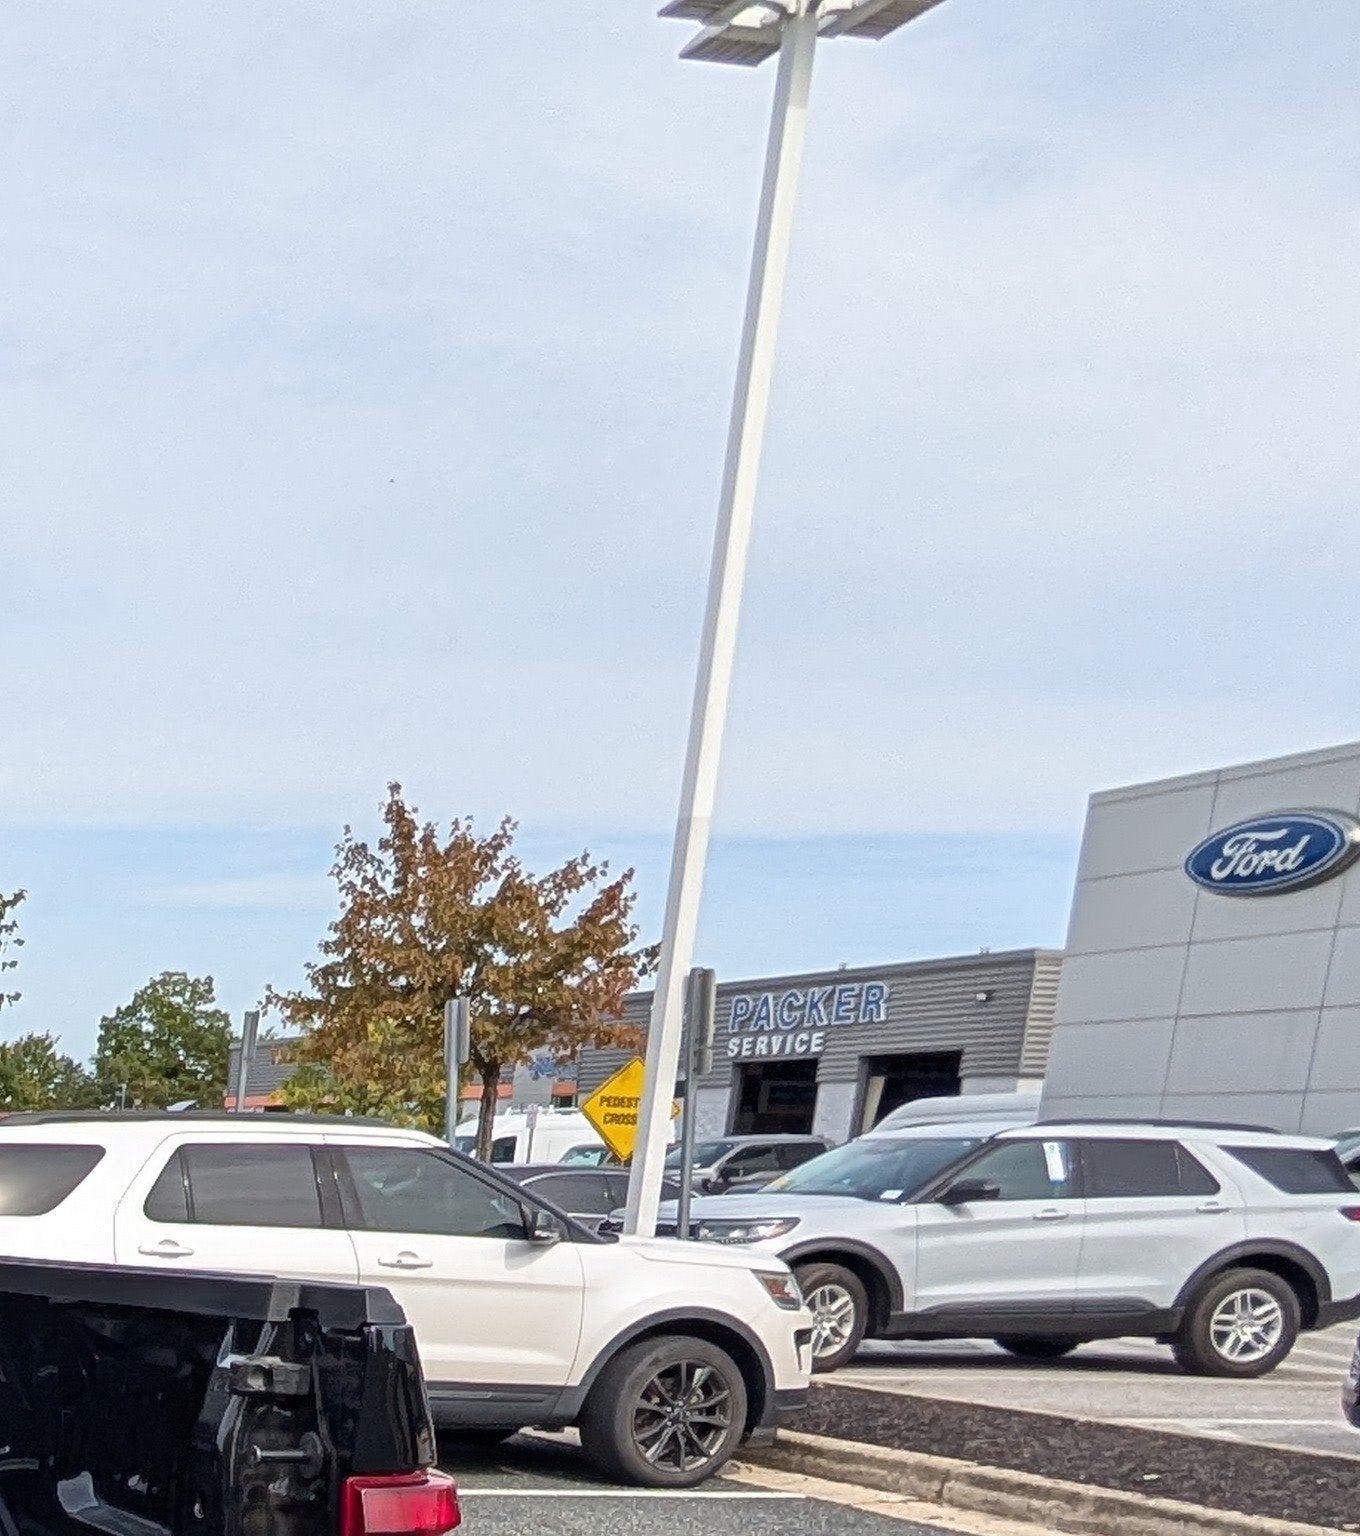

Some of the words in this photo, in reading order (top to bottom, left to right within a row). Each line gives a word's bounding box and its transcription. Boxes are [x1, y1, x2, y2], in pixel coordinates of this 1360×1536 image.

[1210, 828, 1311, 880] Ford
[728, 981, 889, 1033] PACKER
[727, 1031, 825, 1057] SERVICE
[599, 1095, 640, 1108] PEDEST
[603, 1113, 638, 1125] CROSS
